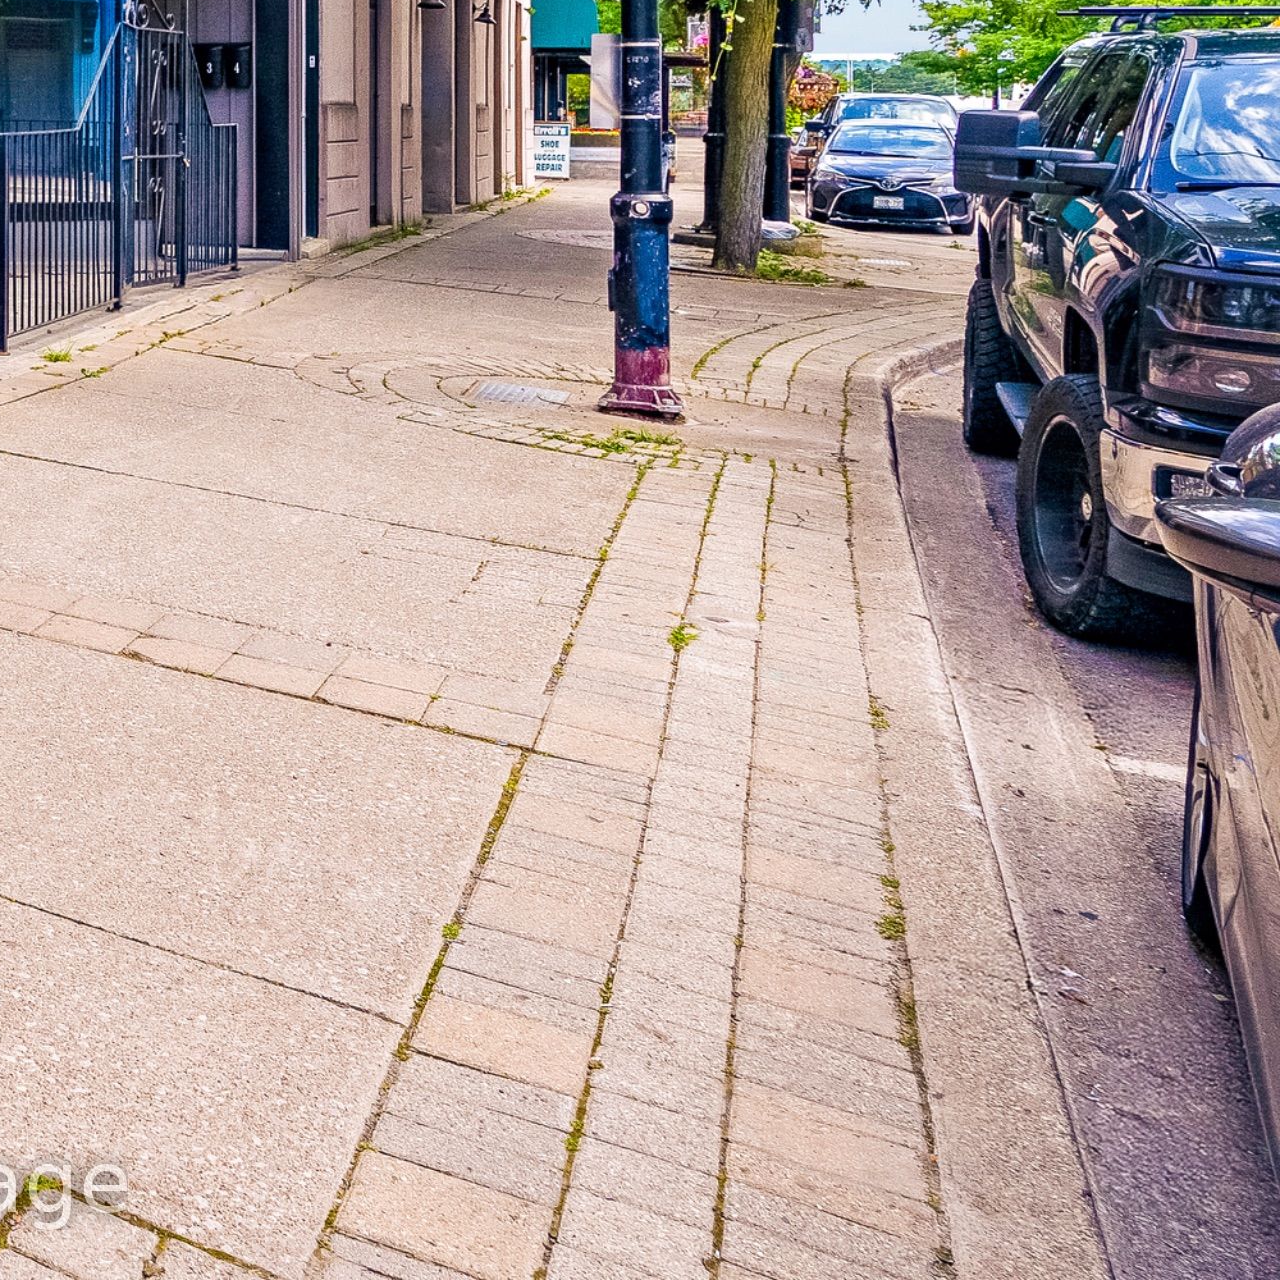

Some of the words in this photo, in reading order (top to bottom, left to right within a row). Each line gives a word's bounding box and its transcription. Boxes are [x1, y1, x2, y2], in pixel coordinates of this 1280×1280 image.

[206, 62, 213, 73] 3
[233, 61, 240, 73] 4
[540, 140, 559, 148] SHOE
[534, 153, 566, 161] LUGGAGE
[536, 163, 562, 172] REPAIR
